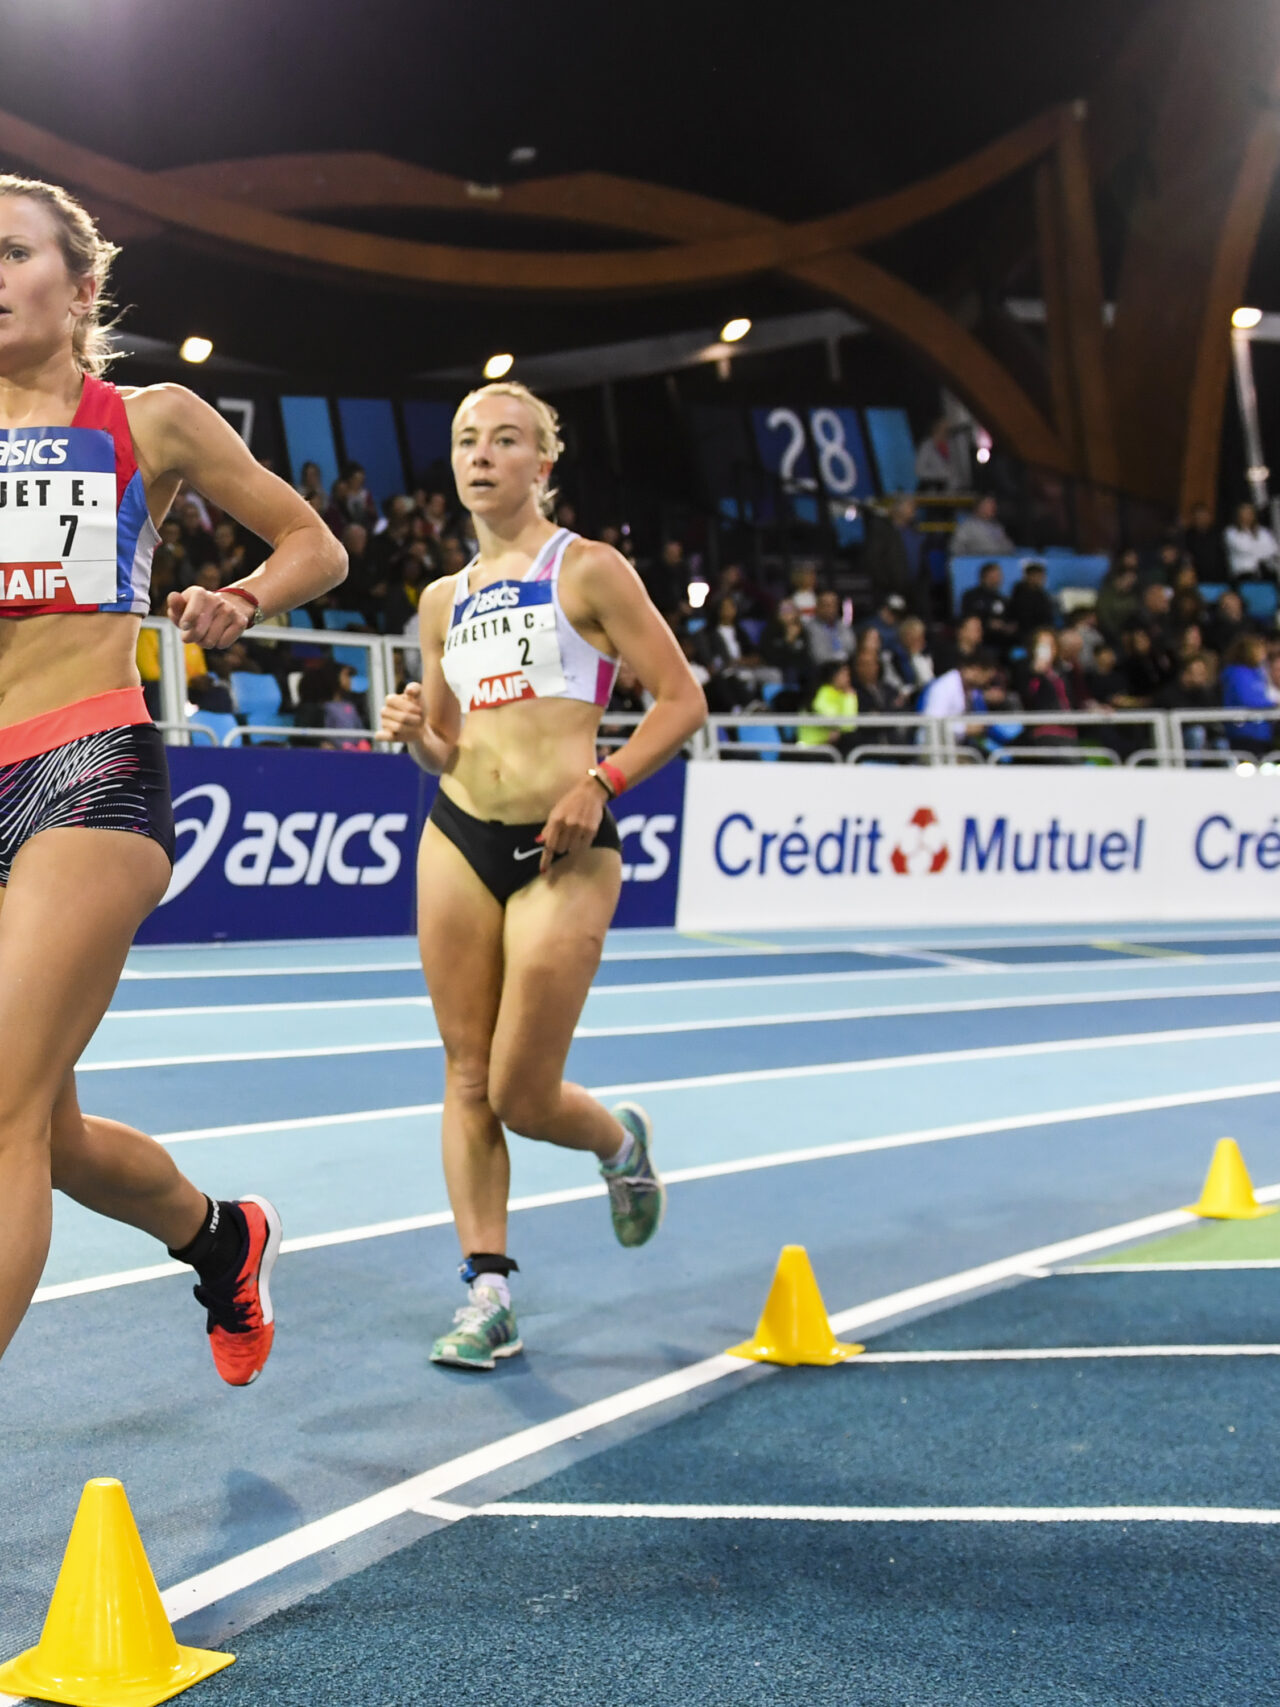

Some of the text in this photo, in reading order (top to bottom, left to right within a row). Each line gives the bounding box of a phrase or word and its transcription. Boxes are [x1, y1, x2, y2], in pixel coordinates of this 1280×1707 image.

[767, 407, 858, 494] 28
[72, 479, 98, 507] E.
[59, 515, 79, 557] 7
[518, 637, 534, 667] 2
[473, 675, 530, 707] MAIF
[223, 811, 408, 886] asics
[714, 811, 1147, 877] Crédit Mutuel
